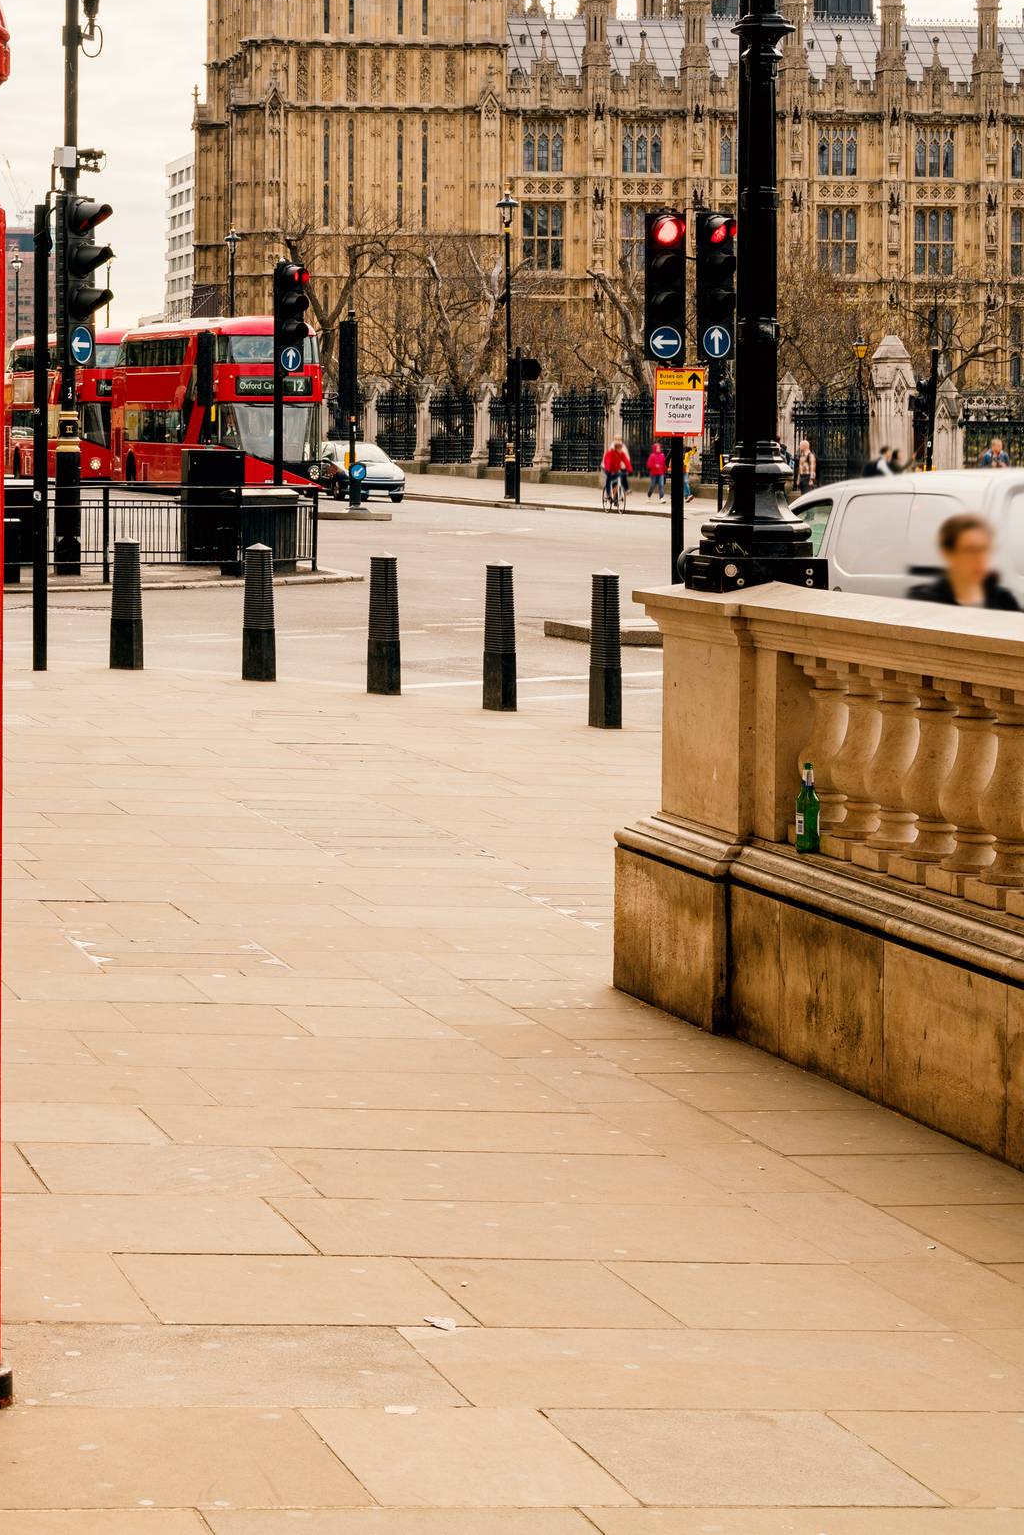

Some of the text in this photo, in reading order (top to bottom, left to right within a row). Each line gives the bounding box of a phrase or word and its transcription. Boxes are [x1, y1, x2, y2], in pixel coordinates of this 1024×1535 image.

[239, 381, 274, 390] Oxford Cir
[293, 380, 304, 392] 12
[664, 403, 695, 411] Trafalgar
